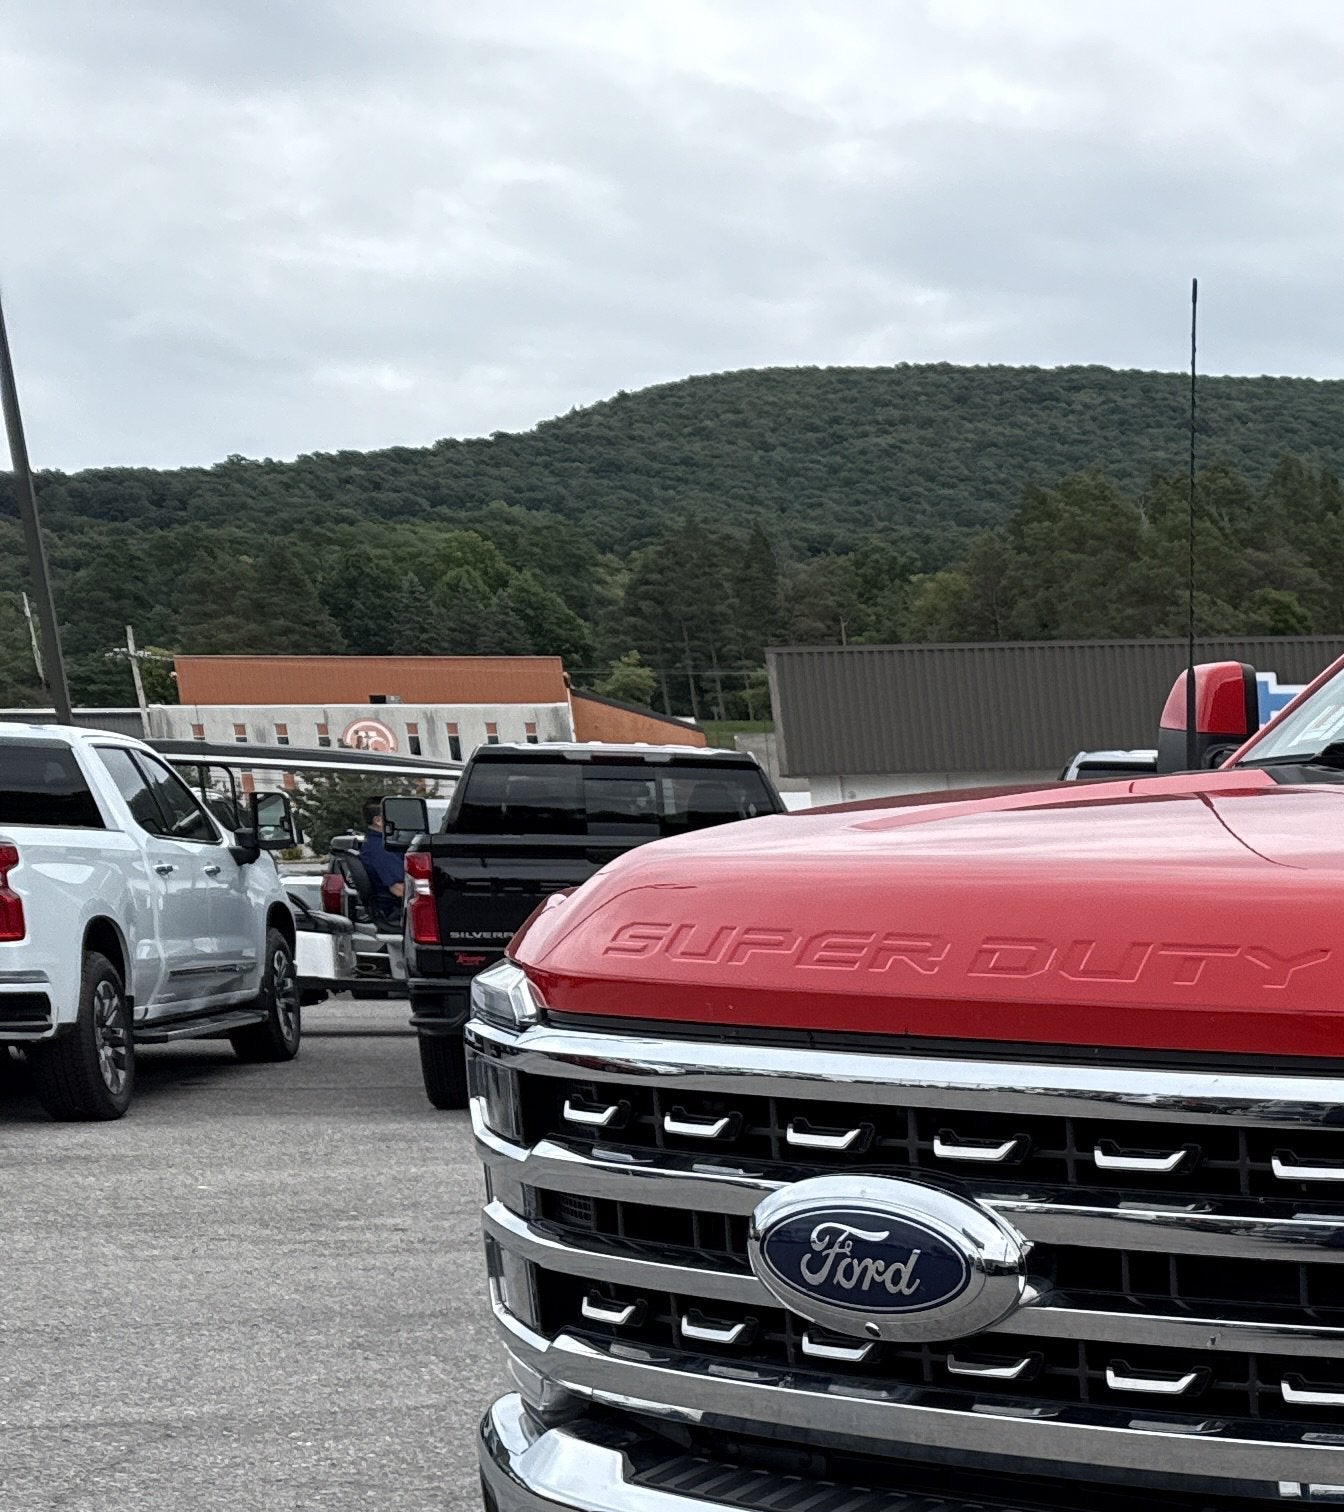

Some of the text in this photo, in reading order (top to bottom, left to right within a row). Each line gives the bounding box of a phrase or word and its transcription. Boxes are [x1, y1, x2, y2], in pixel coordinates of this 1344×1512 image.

[602, 920, 1332, 990] SUPER DUTY
[800, 1221, 922, 1296] Ford
